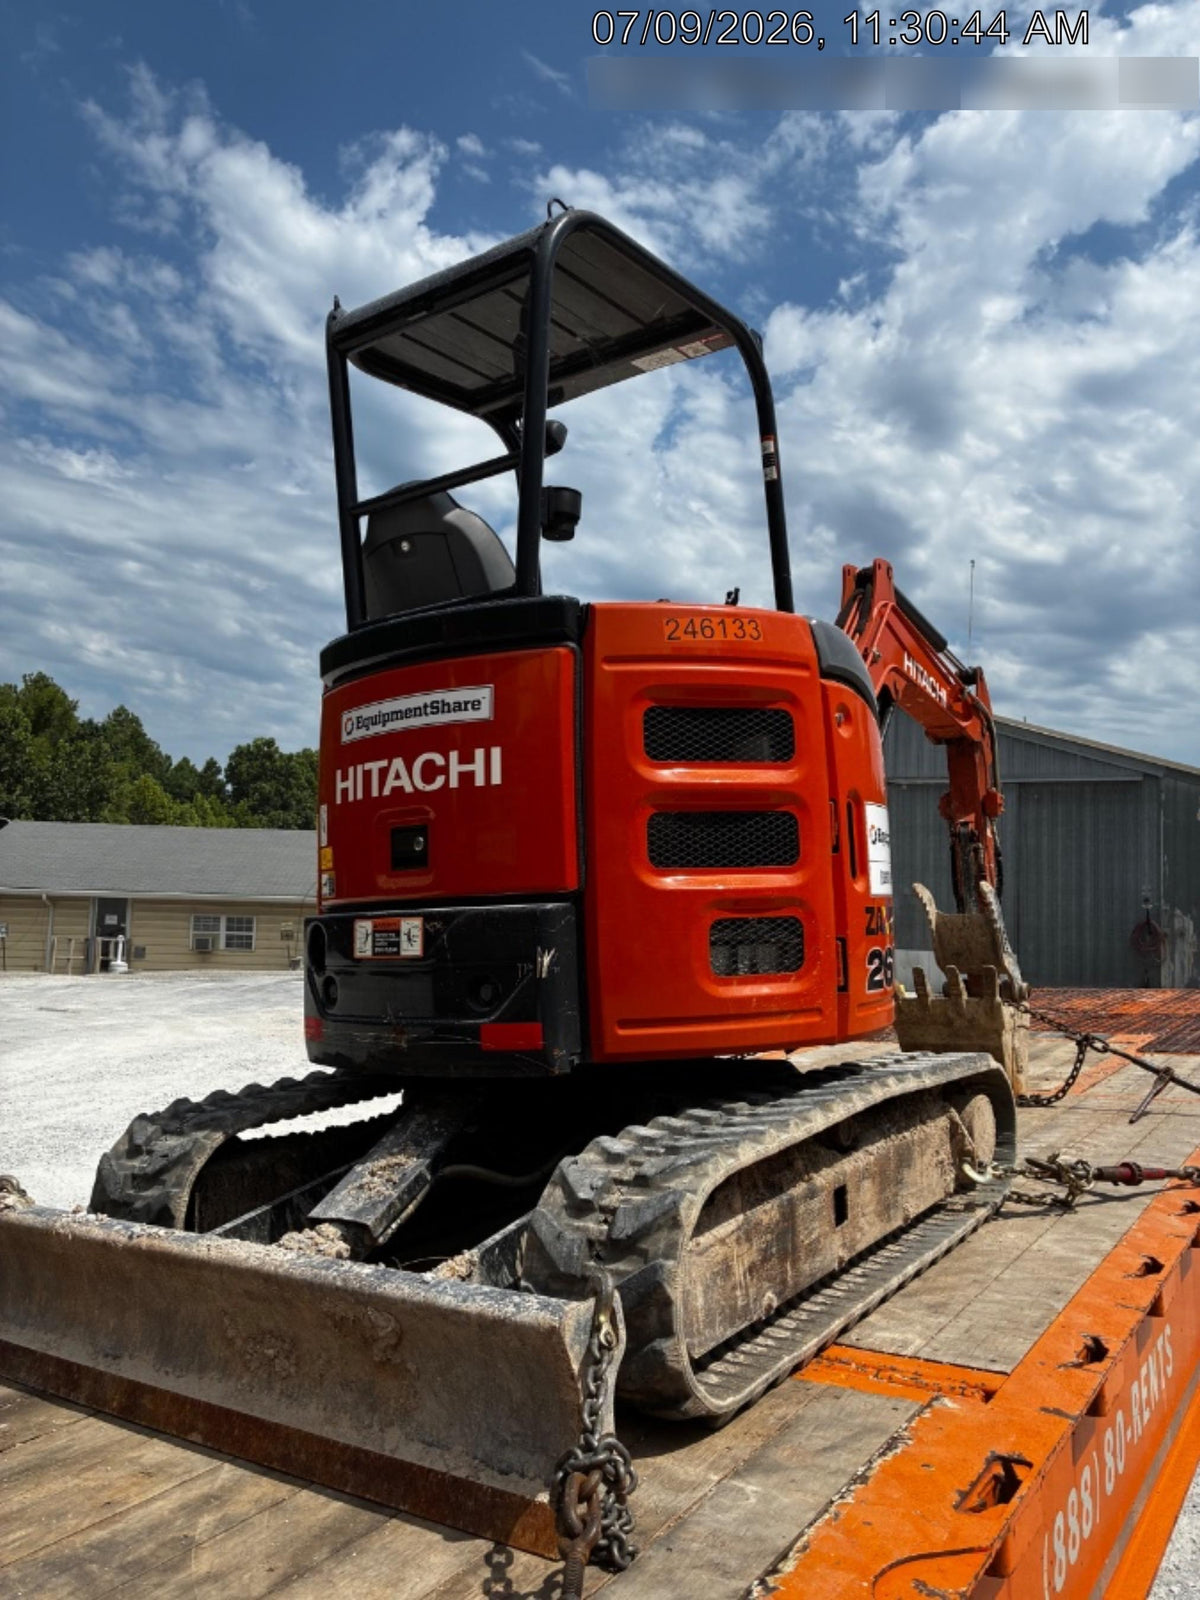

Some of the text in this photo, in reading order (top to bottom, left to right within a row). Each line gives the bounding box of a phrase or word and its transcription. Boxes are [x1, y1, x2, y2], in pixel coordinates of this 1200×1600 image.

[665, 618, 762, 641] 246133
[904, 651, 947, 709] HITACHI
[356, 697, 483, 731] EquipmentShare
[335, 746, 502, 805] HITACHI
[1043, 1323, 1174, 1600] (888) 80-RENTS
